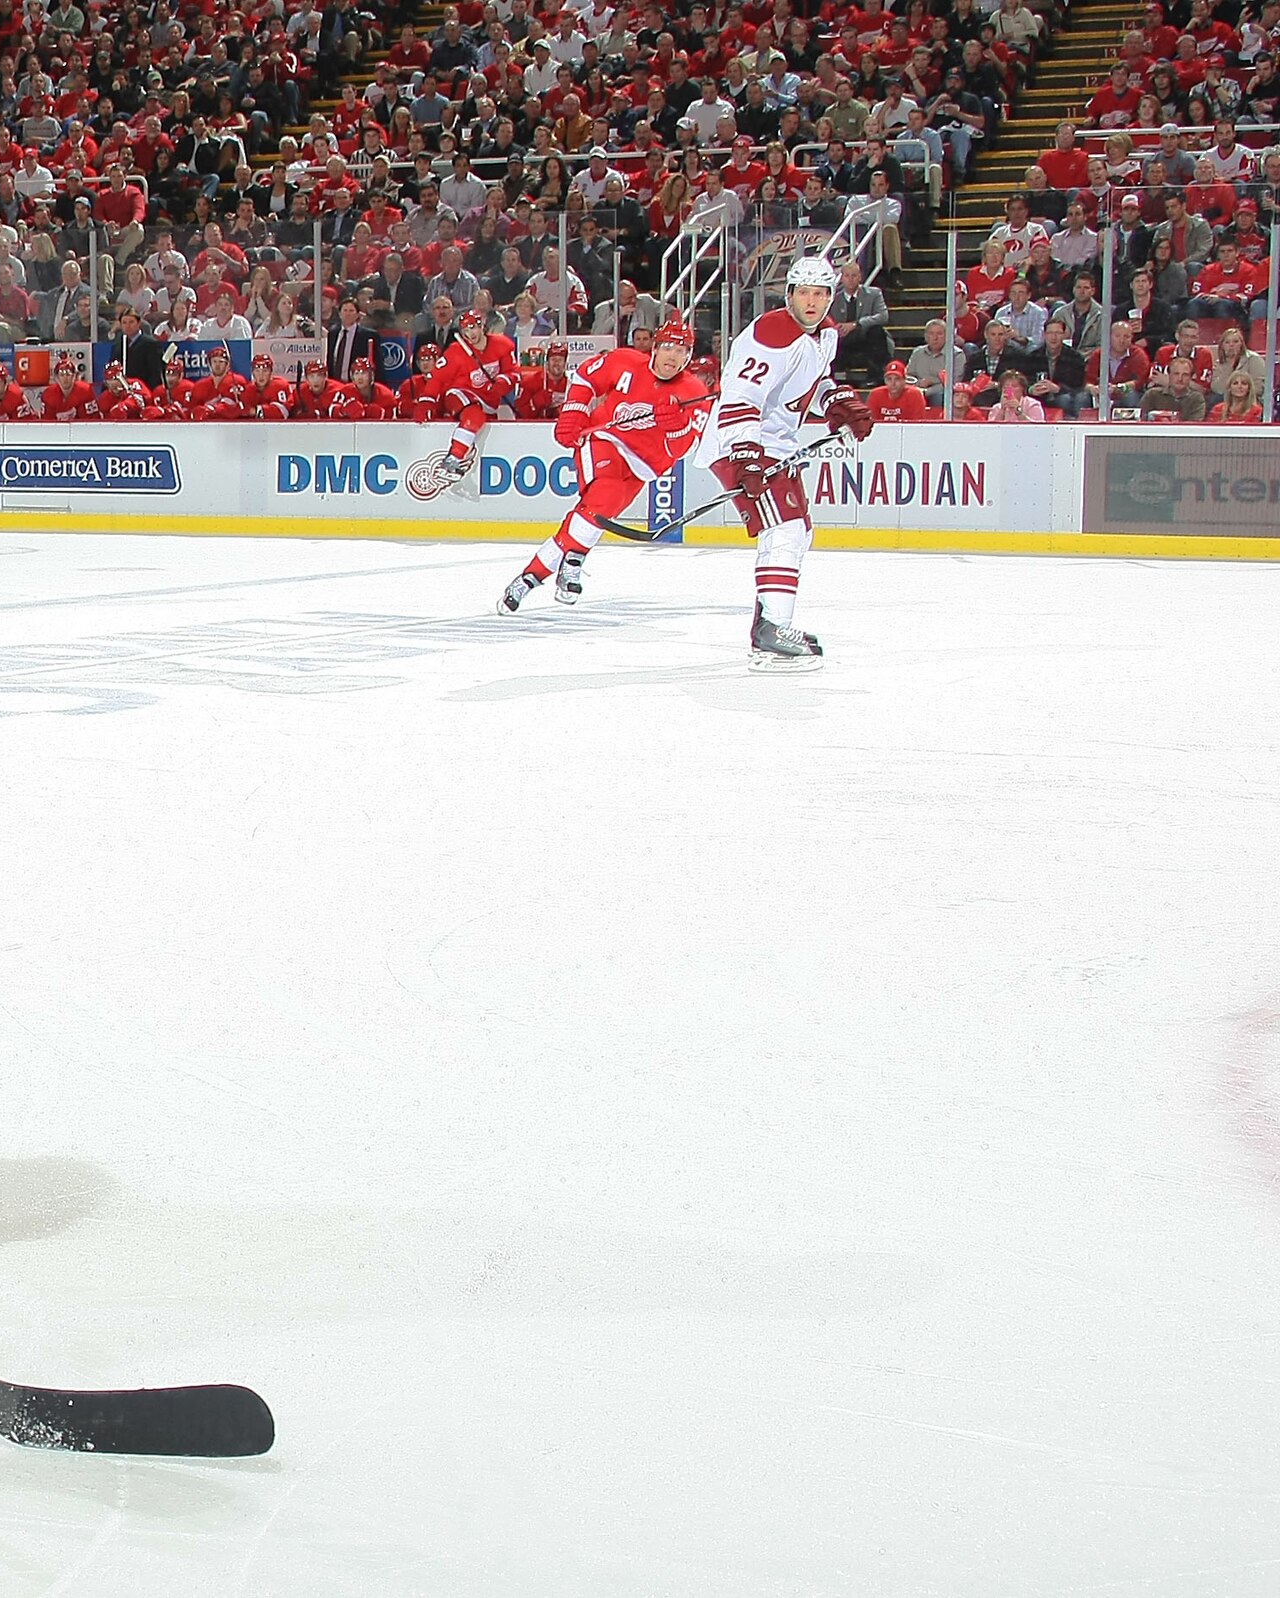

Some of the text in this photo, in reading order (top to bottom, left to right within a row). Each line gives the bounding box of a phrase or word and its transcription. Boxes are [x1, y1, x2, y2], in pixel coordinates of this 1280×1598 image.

[567, 340, 595, 352] state
[18, 356, 29, 372] G
[737, 357, 770, 386] 22
[615, 370, 633, 395] A
[806, 447, 855, 459] OLSON
[105, 456, 163, 479] Bank
[277, 454, 398, 494] DMC
[799, 461, 985, 506] ANADIAN
